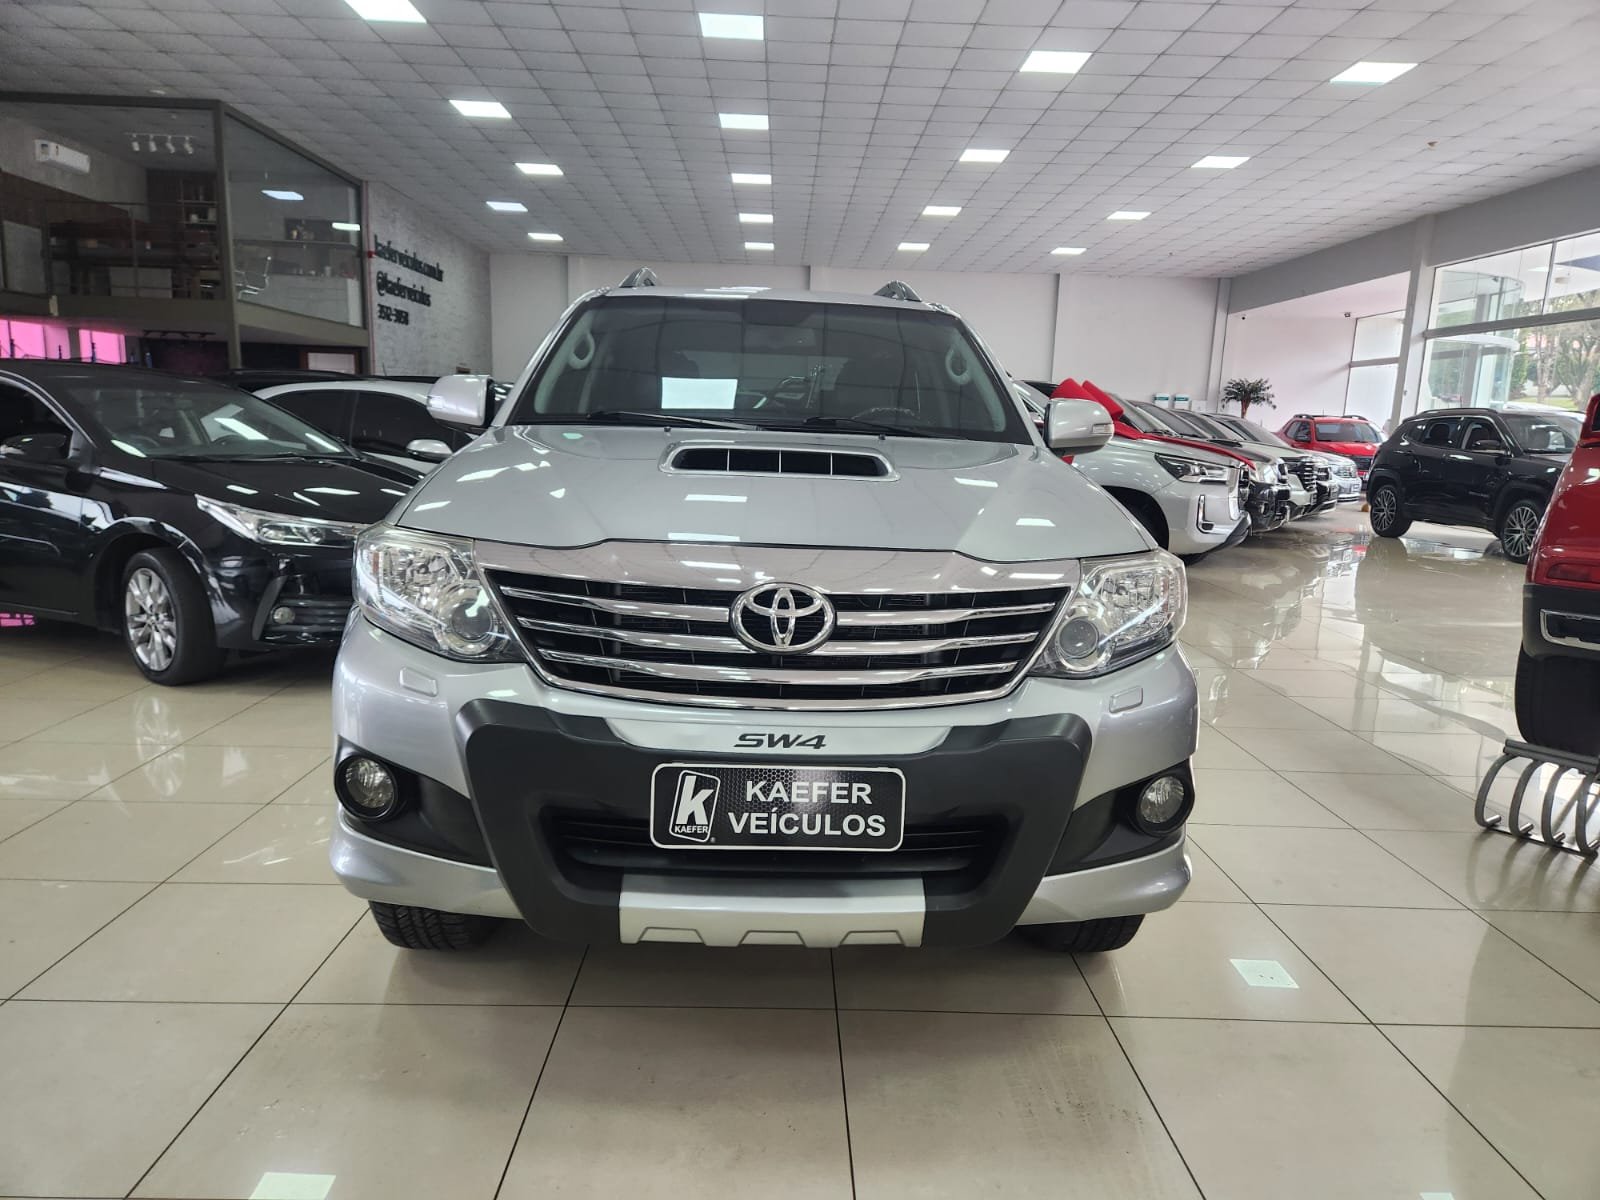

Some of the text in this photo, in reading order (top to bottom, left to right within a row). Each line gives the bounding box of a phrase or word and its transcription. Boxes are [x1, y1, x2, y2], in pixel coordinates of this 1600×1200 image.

[733, 733, 826, 749] SW4
[746, 780, 873, 805] KAEFER
[674, 825, 709, 834] KAEFER
[728, 807, 886, 837] VEÍCULOS
